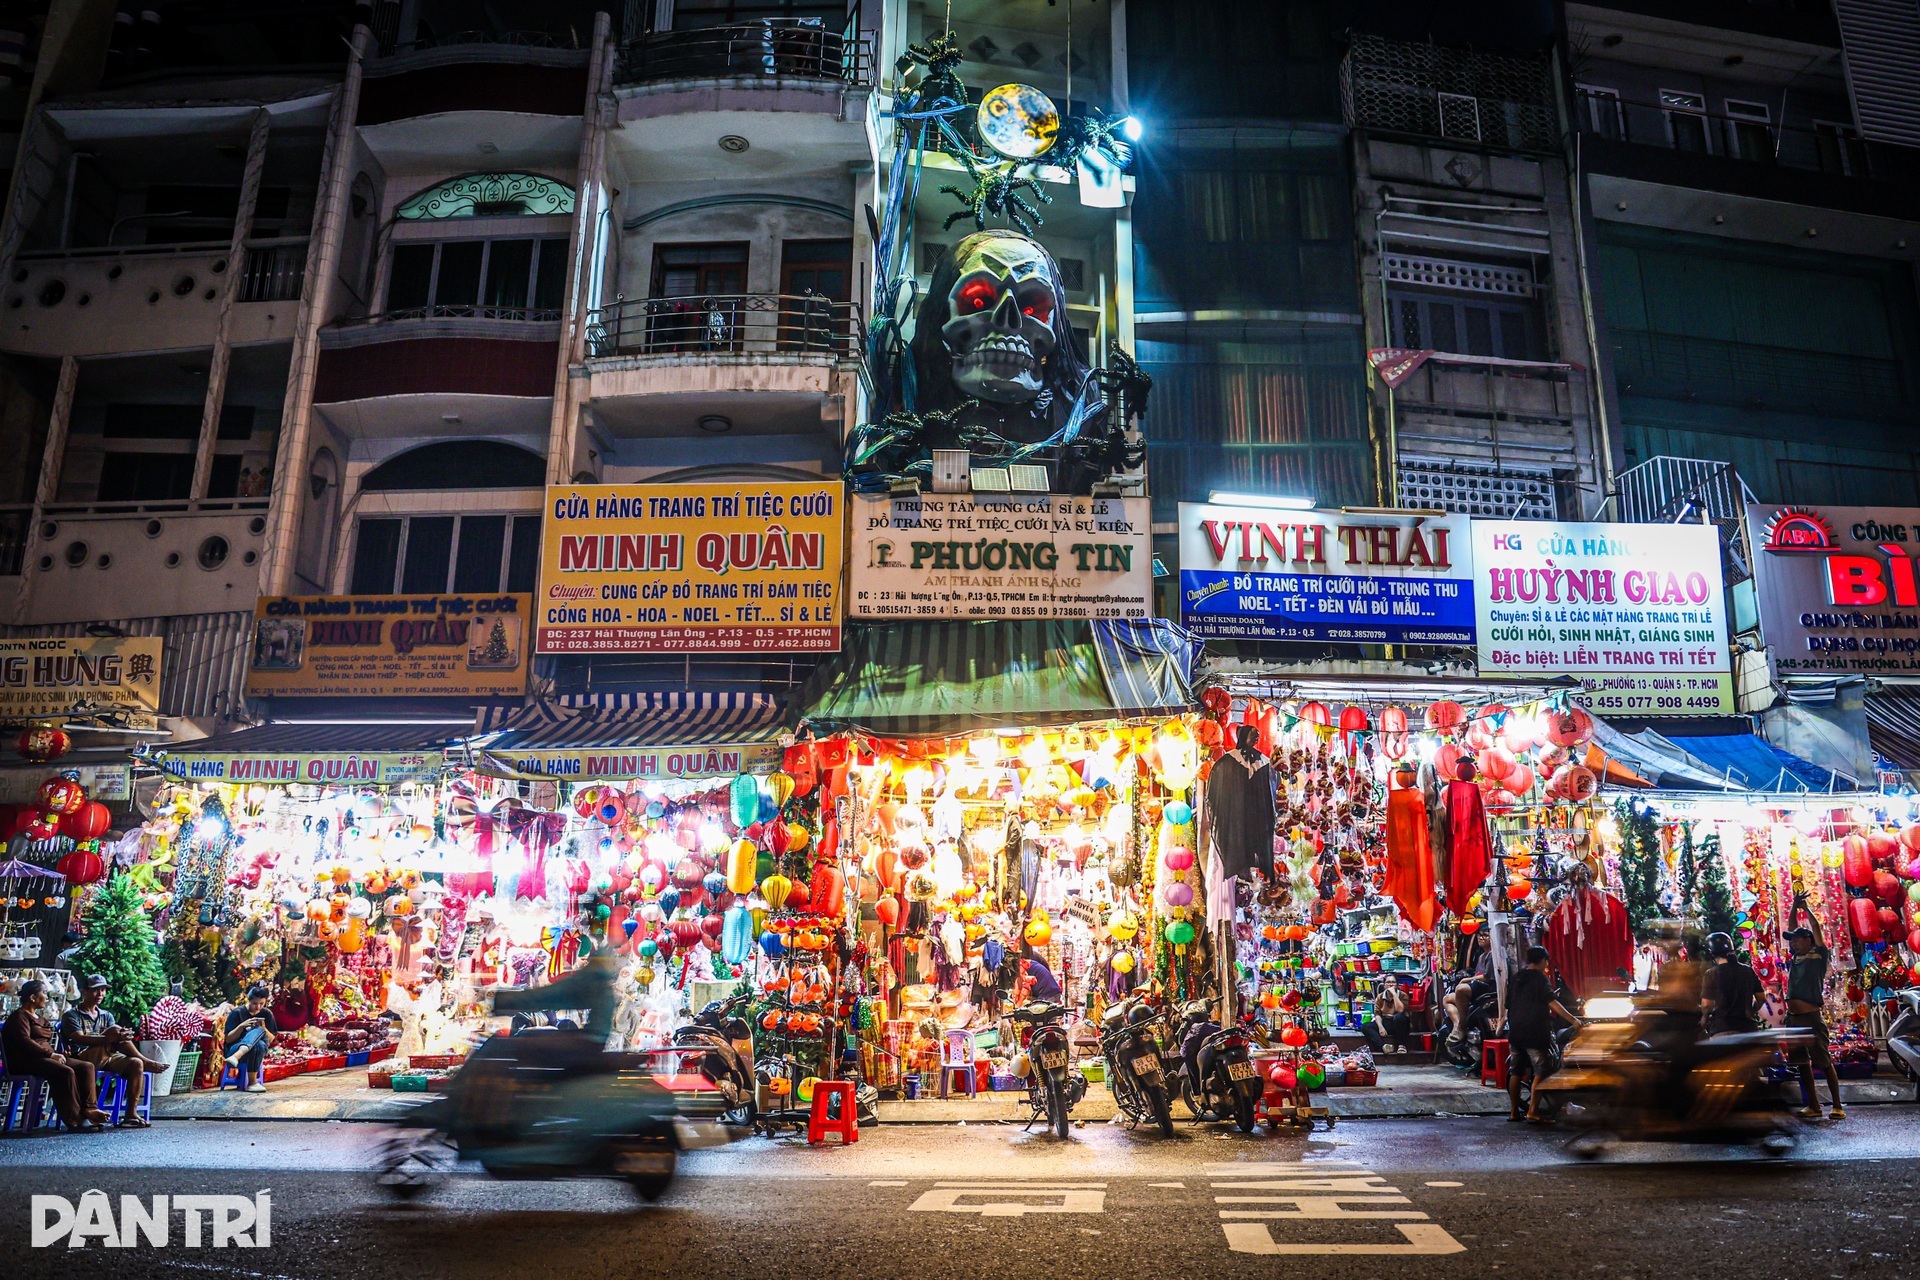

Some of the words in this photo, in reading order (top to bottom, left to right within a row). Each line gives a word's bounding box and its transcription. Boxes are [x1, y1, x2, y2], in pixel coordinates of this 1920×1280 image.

[555, 493, 590, 519] CỬA
[595, 493, 642, 519] HÀNG
[649, 496, 705, 518] TRANG
[711, 490, 740, 517] TRÍ
[745, 491, 783, 521] TIỆC
[790, 490, 833, 517] CƯỚI
[895, 501, 944, 512] TRUNG
[984, 503, 1022, 513] CUNG
[1059, 499, 1073, 514] SỈ
[1076, 504, 1086, 515] &
[1091, 501, 1109, 515] LẺ
[869, 512, 889, 528] ĐỒ
[894, 518, 943, 529] TRANG
[947, 515, 972, 529] TRÍ
[977, 516, 1009, 531] TIỆC
[1015, 517, 1048, 530] CƯỚI
[1053, 517, 1070, 531] VÀ
[1075, 519, 1094, 534] SỰ
[1098, 521, 1134, 534] KIỆN
[1851, 520, 1907, 542] CÔNG
[1201, 519, 1326, 564] VINH
[1337, 517, 1453, 568] THÁI
[1493, 533, 1522, 551] HG
[1536, 532, 1576, 556] CỬA
[1782, 529, 1820, 545] ABM
[559, 534, 684, 572] MINH
[695, 524, 825, 576] QUÂN
[910, 537, 1060, 571] PHƯƠNG
[1070, 543, 1134, 572] TIN
[602, 584, 637, 600] CUNG
[642, 578, 668, 599] CẤP
[672, 579, 690, 599] ĐỒ
[695, 584, 738, 599] TRANG
[742, 580, 764, 598] TRÍ
[767, 580, 798, 599] ĐÁM
[803, 580, 832, 601] TIỆC
[951, 576, 1003, 587] THANH
[1233, 573, 1252, 590] ĐỒ
[1256, 577, 1298, 593] TRANG
[1302, 576, 1323, 593] TRÍ
[1325, 577, 1355, 594] CƯỚI
[1358, 577, 1379, 595] HỎI
[1388, 582, 1430, 597] TRUNG
[1434, 583, 1459, 597] THU
[1489, 558, 1617, 605] HUỲNH
[1623, 570, 1711, 606] GIAO
[1001, 593, 1026, 601] TPHCM
[1239, 595, 1272, 611] NOEL
[1283, 594, 1308, 612] TẾT
[1318, 596, 1344, 613] ĐÈN
[1348, 596, 1368, 614] VẢI
[1371, 598, 1389, 615] ĐỦ
[547, 602, 586, 623] CỔNG
[592, 608, 621, 623] HOA
[637, 607, 667, 622] HOA
[683, 607, 720, 622] NOEL
[736, 601, 775, 622] TẾT...
[780, 602, 794, 622] SỈ
[799, 607, 809, 622] &
[815, 602, 832, 622] LẺ
[1217, 616, 1237, 624] KINH
[1239, 617, 1265, 625] DOANH
[1490, 610, 1530, 624] Chuyên:
[1532, 606, 1542, 622] SỈ
[1545, 611, 1552, 622] &
[1555, 606, 1567, 622] LẺ
[1570, 608, 1590, 622] CÁC
[1593, 609, 1613, 625] MẶT
[1616, 608, 1644, 623] HÀNG
[1646, 611, 1679, 623] TRANG
[1682, 609, 1698, 623] TRÍ
[1800, 611, 1877, 629] CHUYÊN
[1880, 612, 1918, 629] BÁN
[308, 620, 384, 646] MINH
[390, 613, 471, 655] QUÂN
[547, 630, 567, 639] ĐC:
[570, 630, 591, 639] 237
[595, 628, 613, 639] Hải
[617, 629, 657, 643] Thượng
[661, 629, 680, 639] Lãn
[684, 627, 705, 642] Ông
[718, 630, 743, 639] P.13
[755, 629, 775, 640] Q.5
[787, 629, 831, 638] TP.HCM
[1189, 625, 1203, 634] 241
[1204, 625, 1217, 634] HẢI
[1280, 628, 1297, 637] P.13
[1302, 629, 1315, 638] Q.5
[1338, 630, 1386, 639] 028.38570799
[1491, 625, 1524, 641] CƯỚI
[1528, 624, 1556, 643] HỎI,
[1559, 629, 1591, 642] SINH
[1595, 627, 1635, 645] NHẬT,
[1639, 627, 1680, 642] GIÁNG
[1684, 630, 1715, 642] SINH
[29, 640, 67, 652] NGỌC
[547, 640, 565, 649] ĐT:
[568, 640, 651, 649] 028.3853.8271
[664, 640, 741, 649] 077.8844.999
[753, 639, 831, 648] 077.462.8899
[1807, 637, 1859, 655] DỤNG
[1861, 638, 1887, 656] CỤ
[1491, 650, 1522, 668] Đặc
[1525, 650, 1559, 669] biệt:
[1563, 644, 1599, 665] LIỄN
[1602, 651, 1655, 665] TRANG
[1659, 648, 1684, 665] TRÍ
[1688, 646, 1716, 665] TẾT
[1827, 656, 1848, 669] HẢI
[1852, 659, 1899, 671] THƯỢNG
[34, 649, 123, 687] HƯNG
[1603, 675, 1636, 690] PHƯỜNG
[1638, 679, 1647, 689] 13
[1653, 677, 1675, 692] QUẬN
[1677, 679, 1682, 690] 5
[1687, 679, 1699, 690] TP.
[1701, 679, 1718, 689] HCM
[1597, 697, 1623, 708] 455
[1627, 697, 1652, 708] 077
[1656, 697, 1682, 708] 908
[1686, 697, 1720, 708] 4499
[190, 757, 224, 777] HÀNG
[229, 759, 302, 781] MINH
[307, 754, 380, 782] QUÂN
[516, 754, 543, 775] CỬA
[546, 755, 581, 775] HÀNG
[586, 755, 659, 777] MINH
[666, 748, 741, 776] QUÂN
